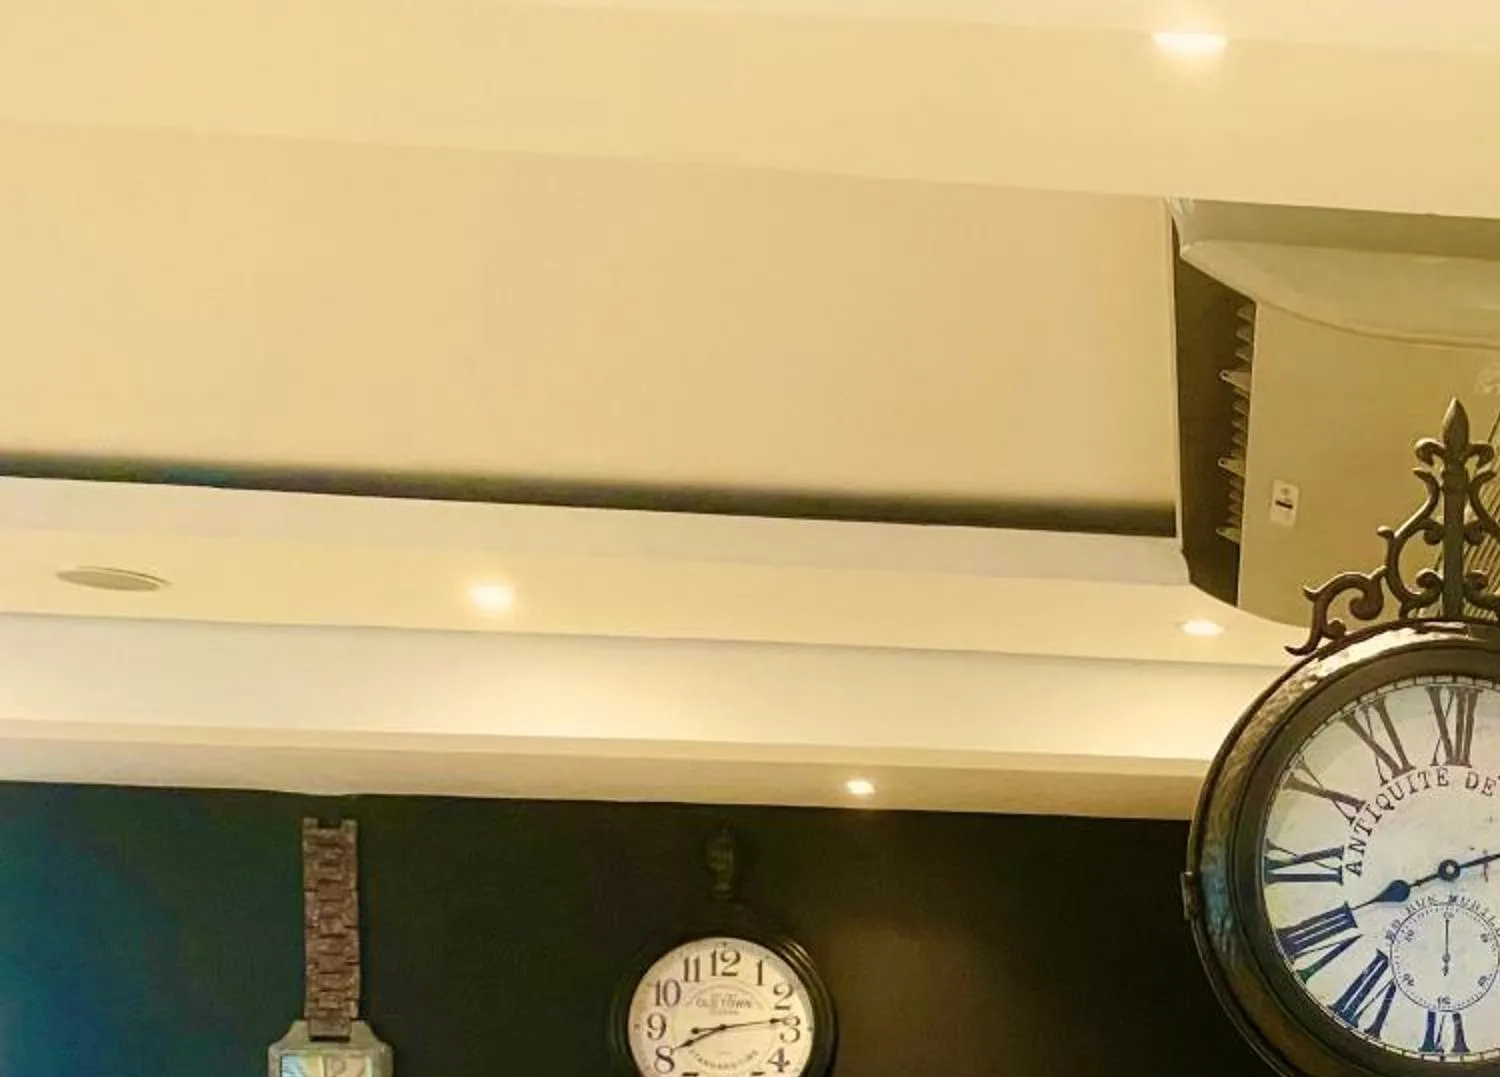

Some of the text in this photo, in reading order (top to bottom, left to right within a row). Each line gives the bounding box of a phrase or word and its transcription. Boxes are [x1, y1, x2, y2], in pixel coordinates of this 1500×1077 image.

[1426, 686, 1484, 768] XII
[1340, 696, 1416, 787] XI
[1281, 755, 1367, 825] X
[1344, 767, 1450, 877] ANTIQUITE
[1464, 770, 1497, 798] DE
[1264, 837, 1345, 885] IX
[1274, 902, 1364, 984] VIII
[683, 956, 700, 983] 11
[709, 949, 741, 977] 12
[756, 960, 764, 986] 1
[655, 979, 681, 1007] 10
[773, 983, 794, 1010] 2
[647, 1013, 667, 1041] 9
[779, 1014, 801, 1043] 3
[654, 1045, 676, 1073] 8
[768, 1047, 790, 1073] 4
